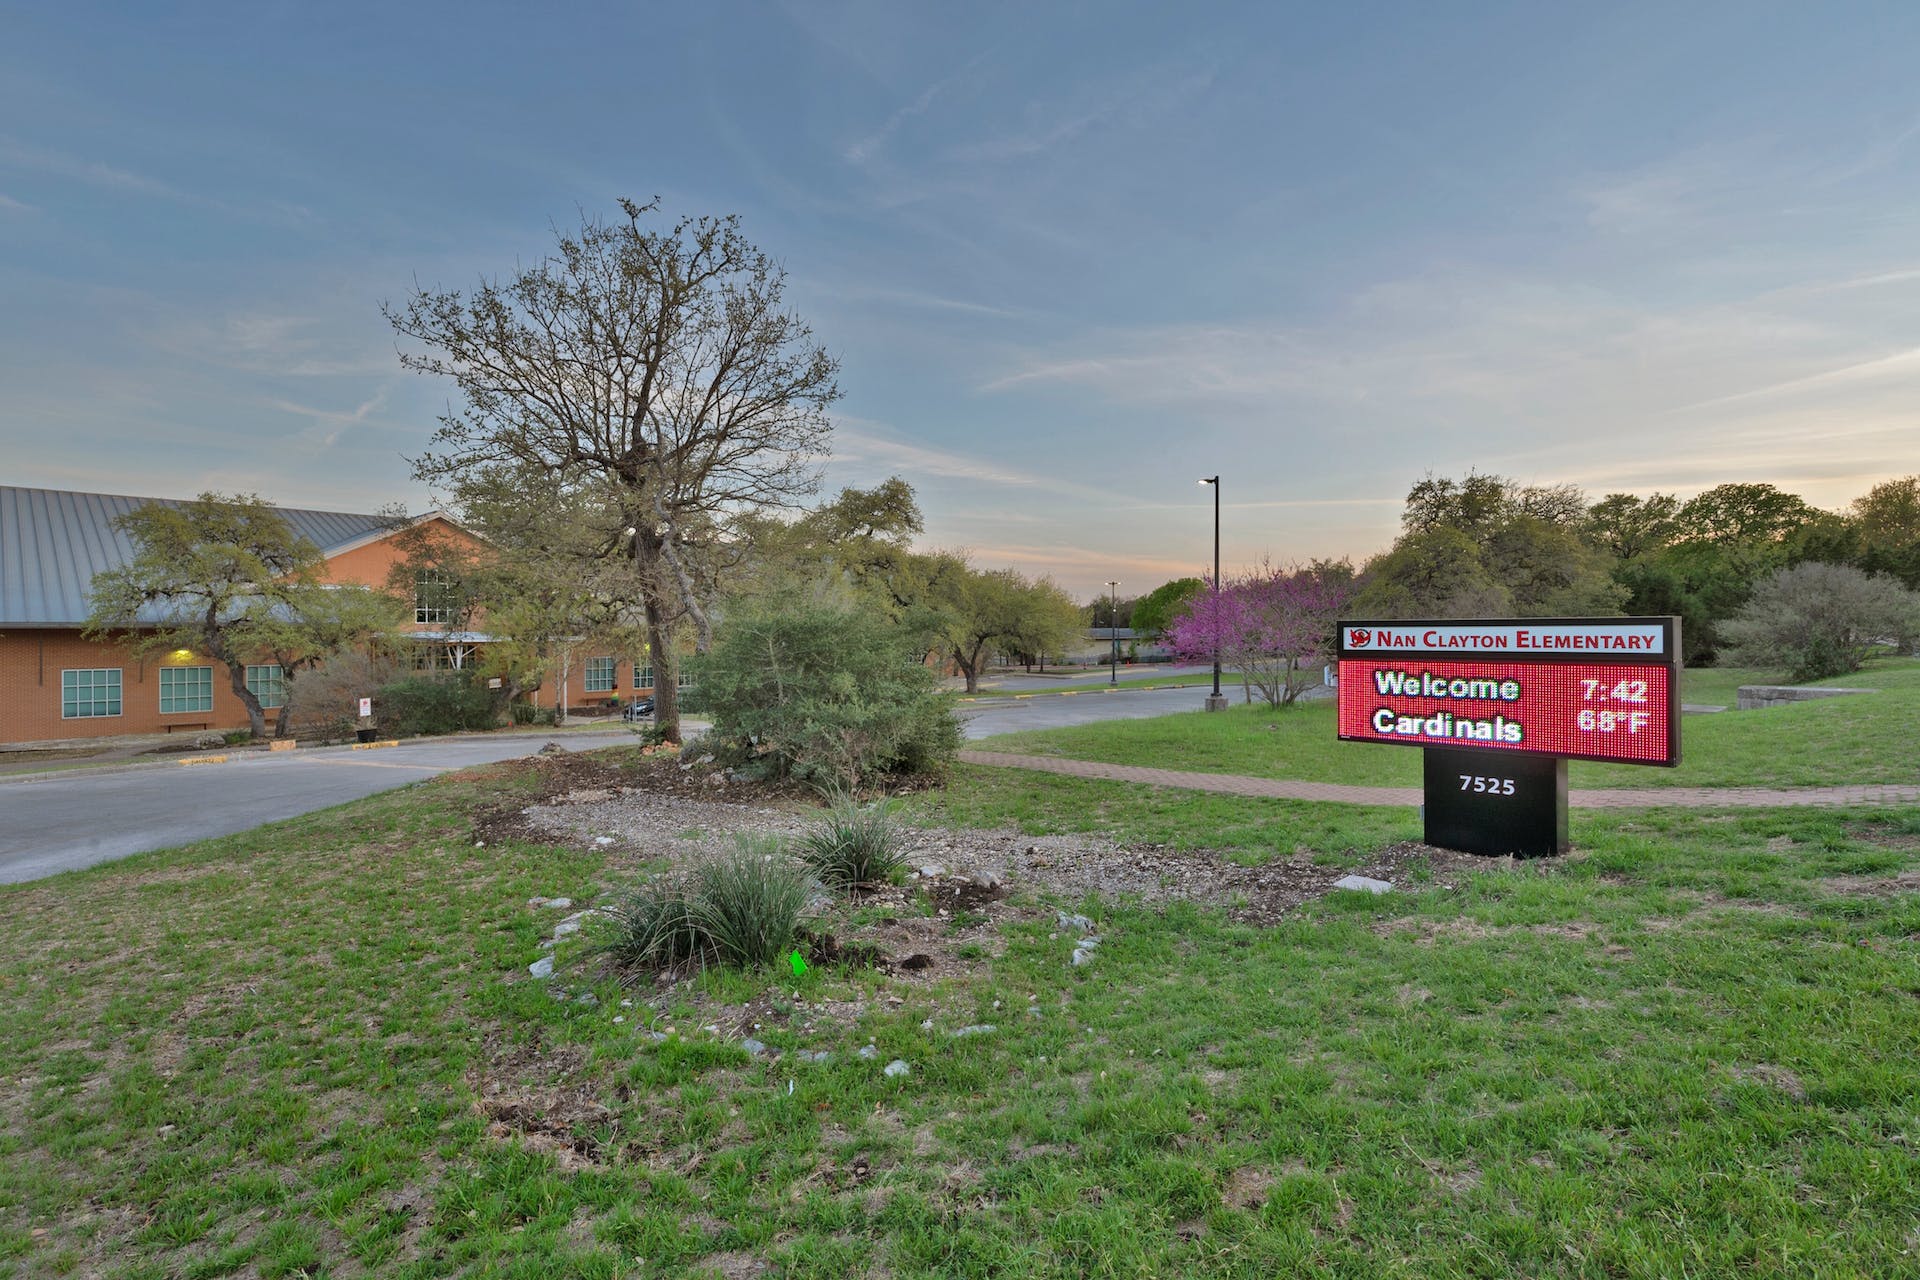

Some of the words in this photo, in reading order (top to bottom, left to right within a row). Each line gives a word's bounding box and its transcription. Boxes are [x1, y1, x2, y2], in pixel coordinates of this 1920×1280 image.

[1375, 671, 1521, 701] Welcome
[1580, 680, 1648, 703] 7:42
[1373, 709, 1523, 743] Cardinals
[1459, 775, 1515, 796] 7525
